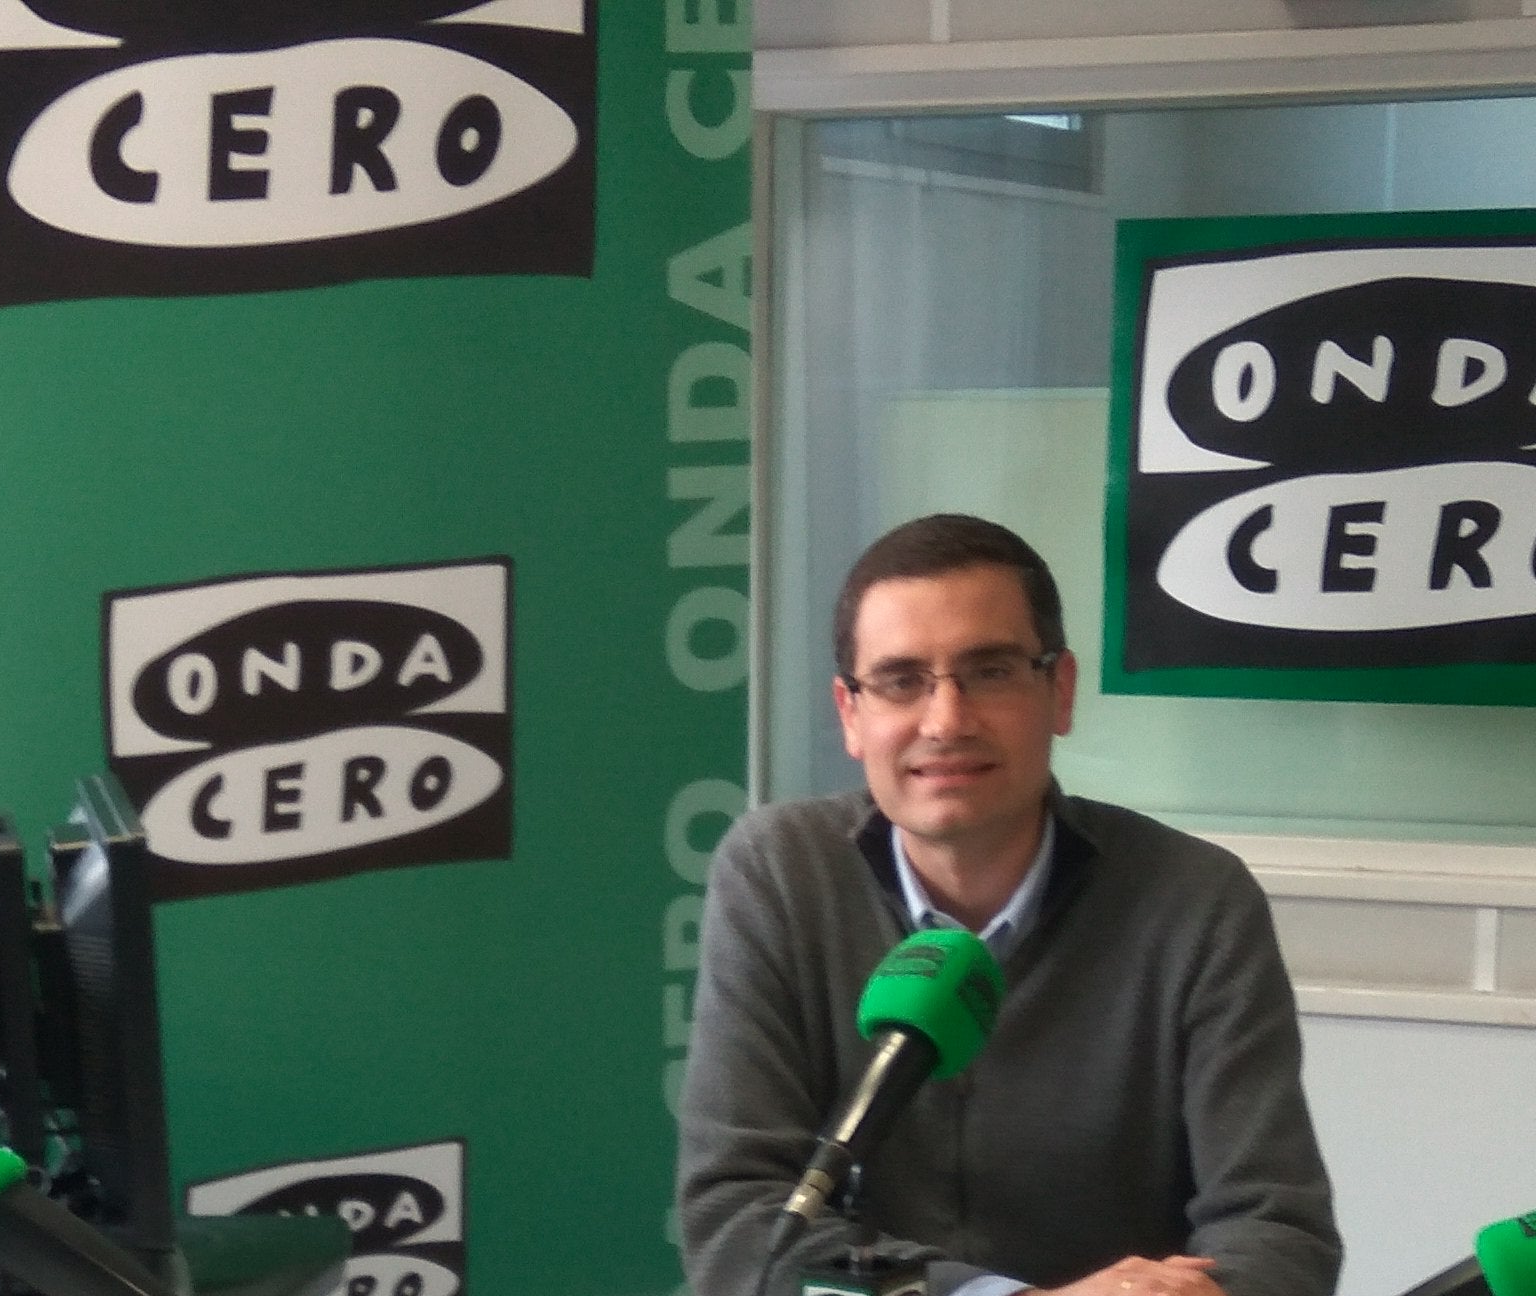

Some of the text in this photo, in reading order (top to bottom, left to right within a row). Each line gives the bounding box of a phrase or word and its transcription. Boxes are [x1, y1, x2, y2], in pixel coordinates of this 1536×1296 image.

[89, 84, 504, 204] CERO
[665, 220, 753, 692] ONDA
[167, 633, 453, 715] ONDA
[190, 754, 454, 840] CERO
